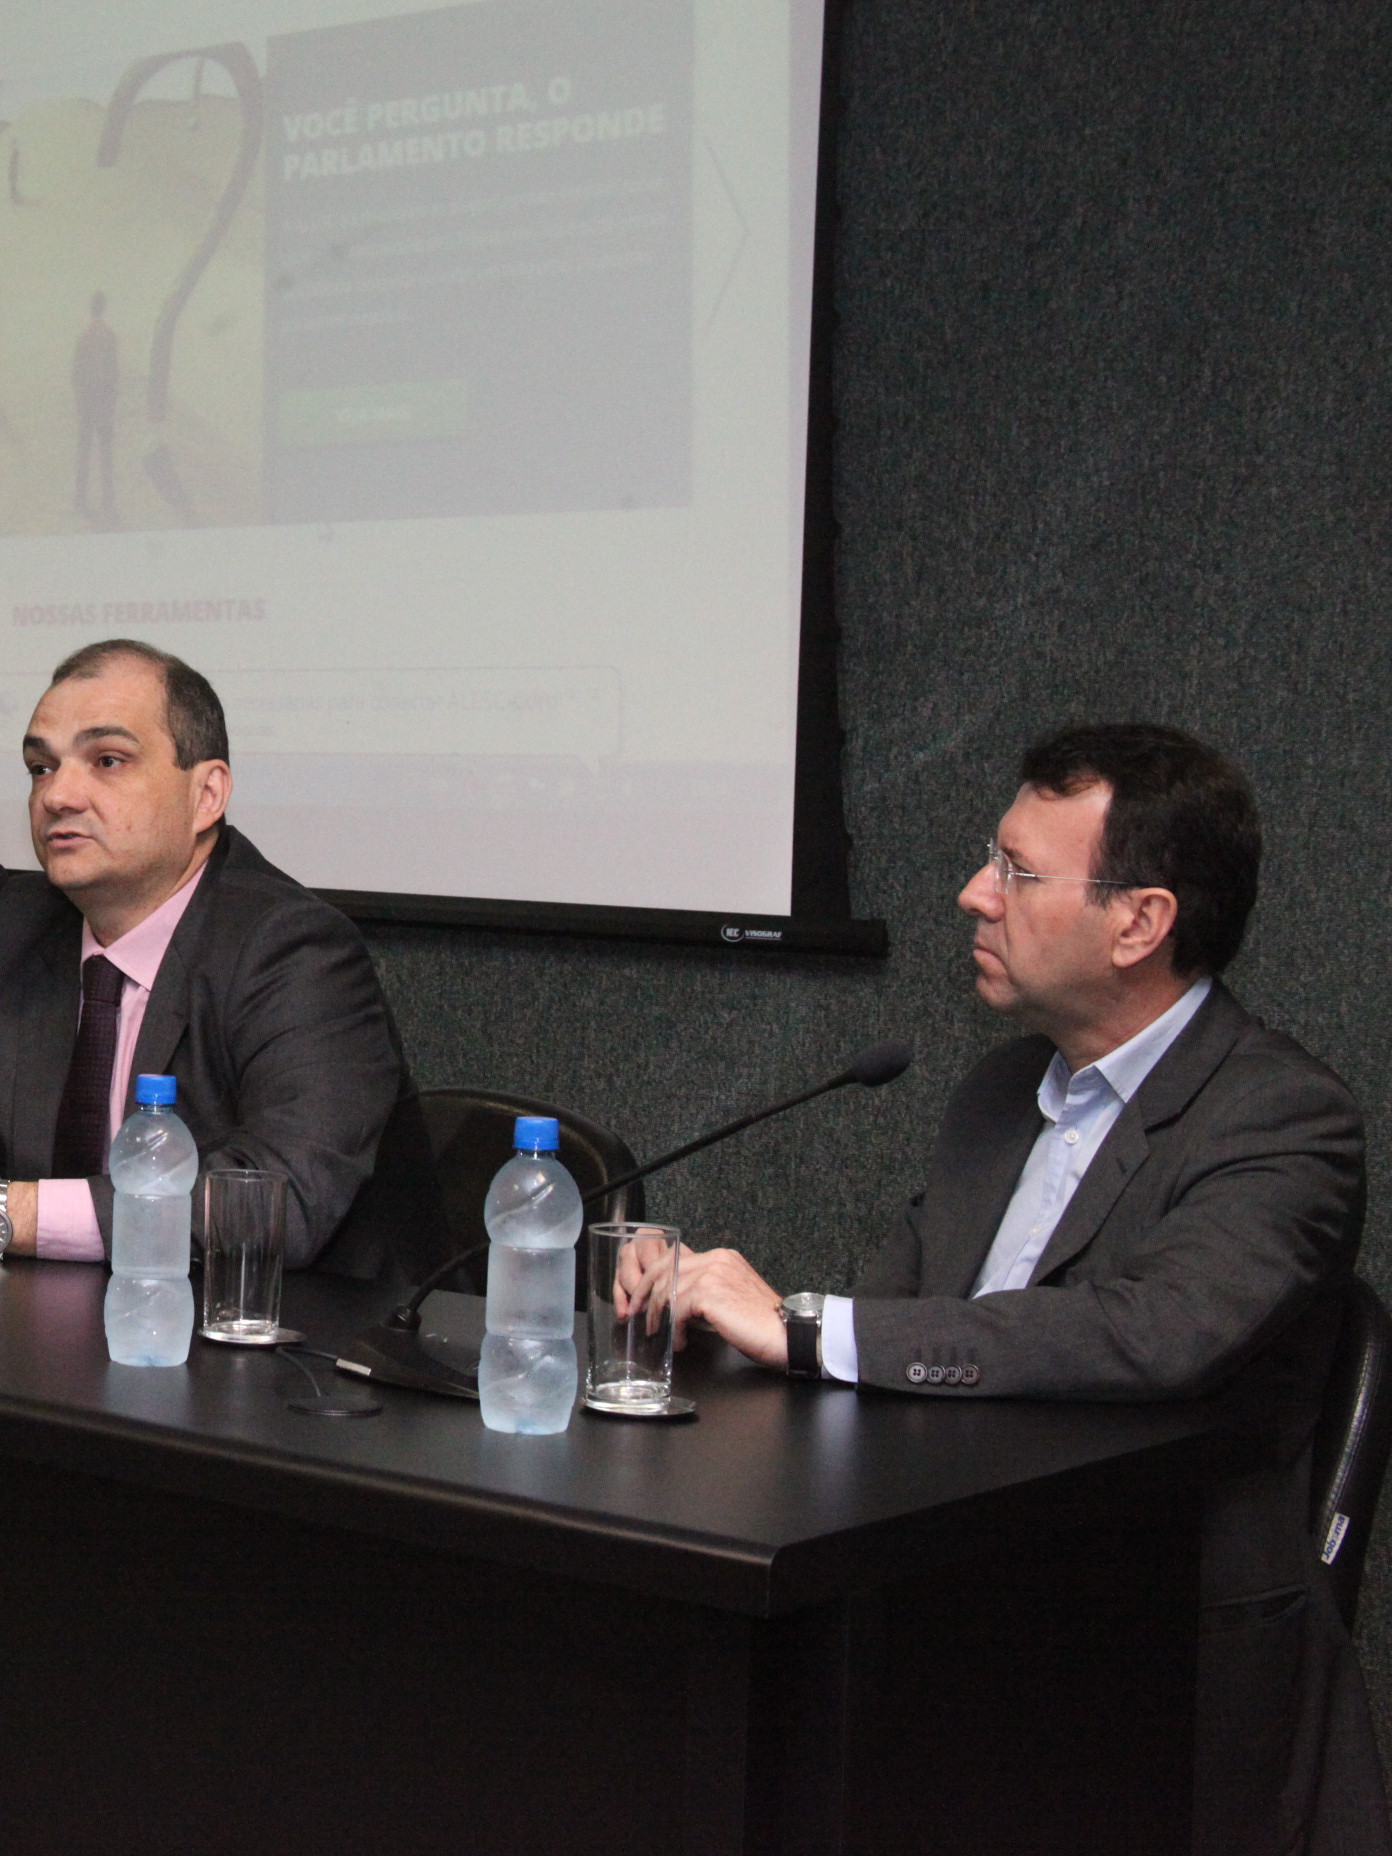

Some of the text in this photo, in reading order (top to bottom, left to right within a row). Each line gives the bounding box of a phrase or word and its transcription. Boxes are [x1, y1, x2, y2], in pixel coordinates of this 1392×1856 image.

[282, 97, 359, 143] VOCÊ
[547, 75, 573, 106] O
[282, 102, 667, 182] PARLAMENTO RESPONDE
[12, 597, 267, 627] NOSSAS FERRAMENTAS
[1321, 1512, 1345, 1560] Jobma
